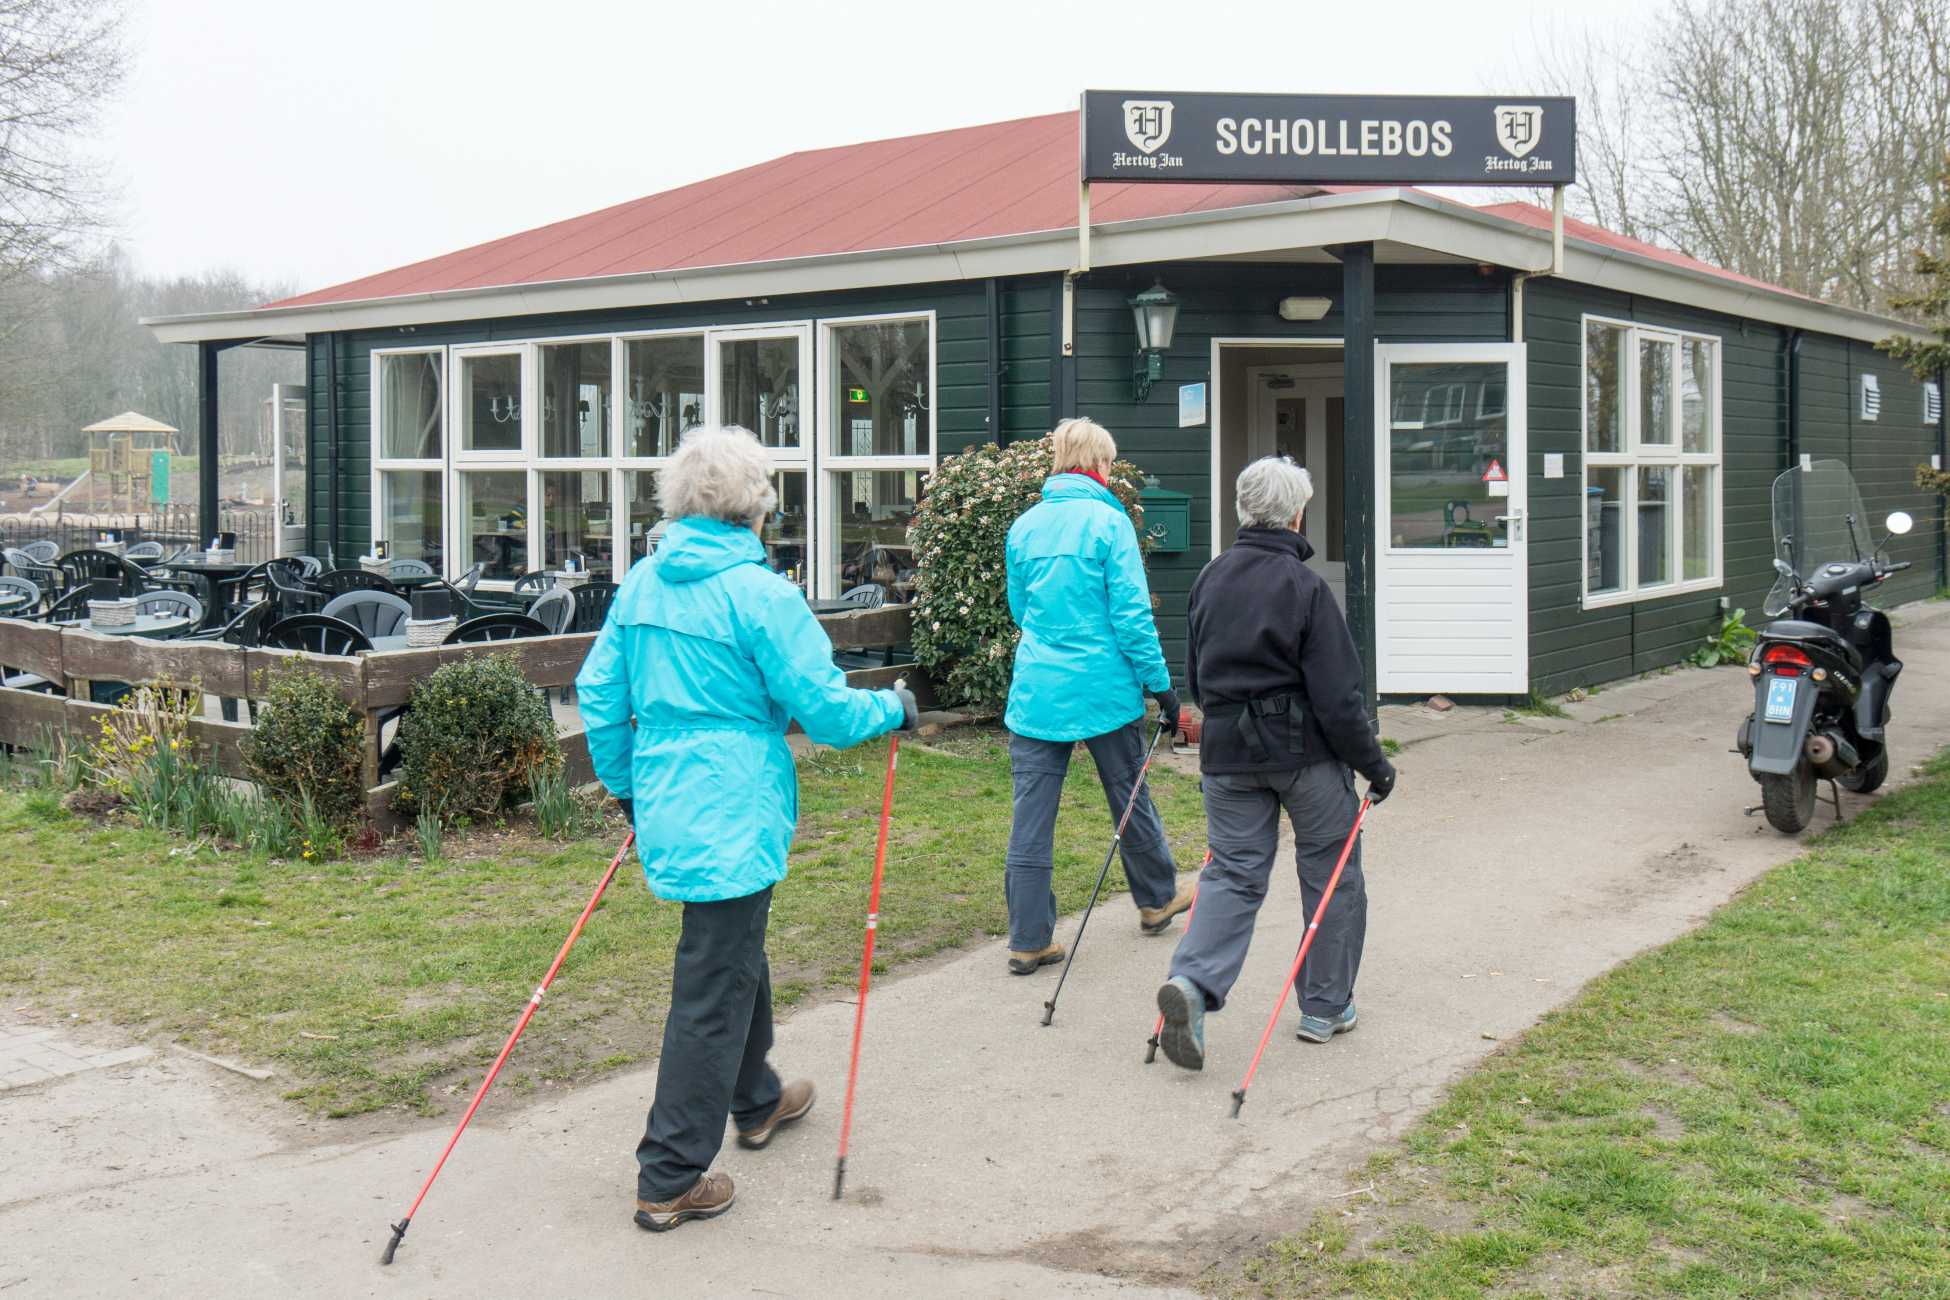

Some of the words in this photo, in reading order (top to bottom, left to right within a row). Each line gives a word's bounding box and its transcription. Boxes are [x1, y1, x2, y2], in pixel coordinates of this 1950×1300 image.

[1216, 118, 1452, 157] SCHOLLEBOS
[1112, 152, 1157, 170] Hertog
[1158, 153, 1184, 170] Jan
[1484, 155, 1528, 173] Hertog
[1528, 156, 1553, 173] Jan
